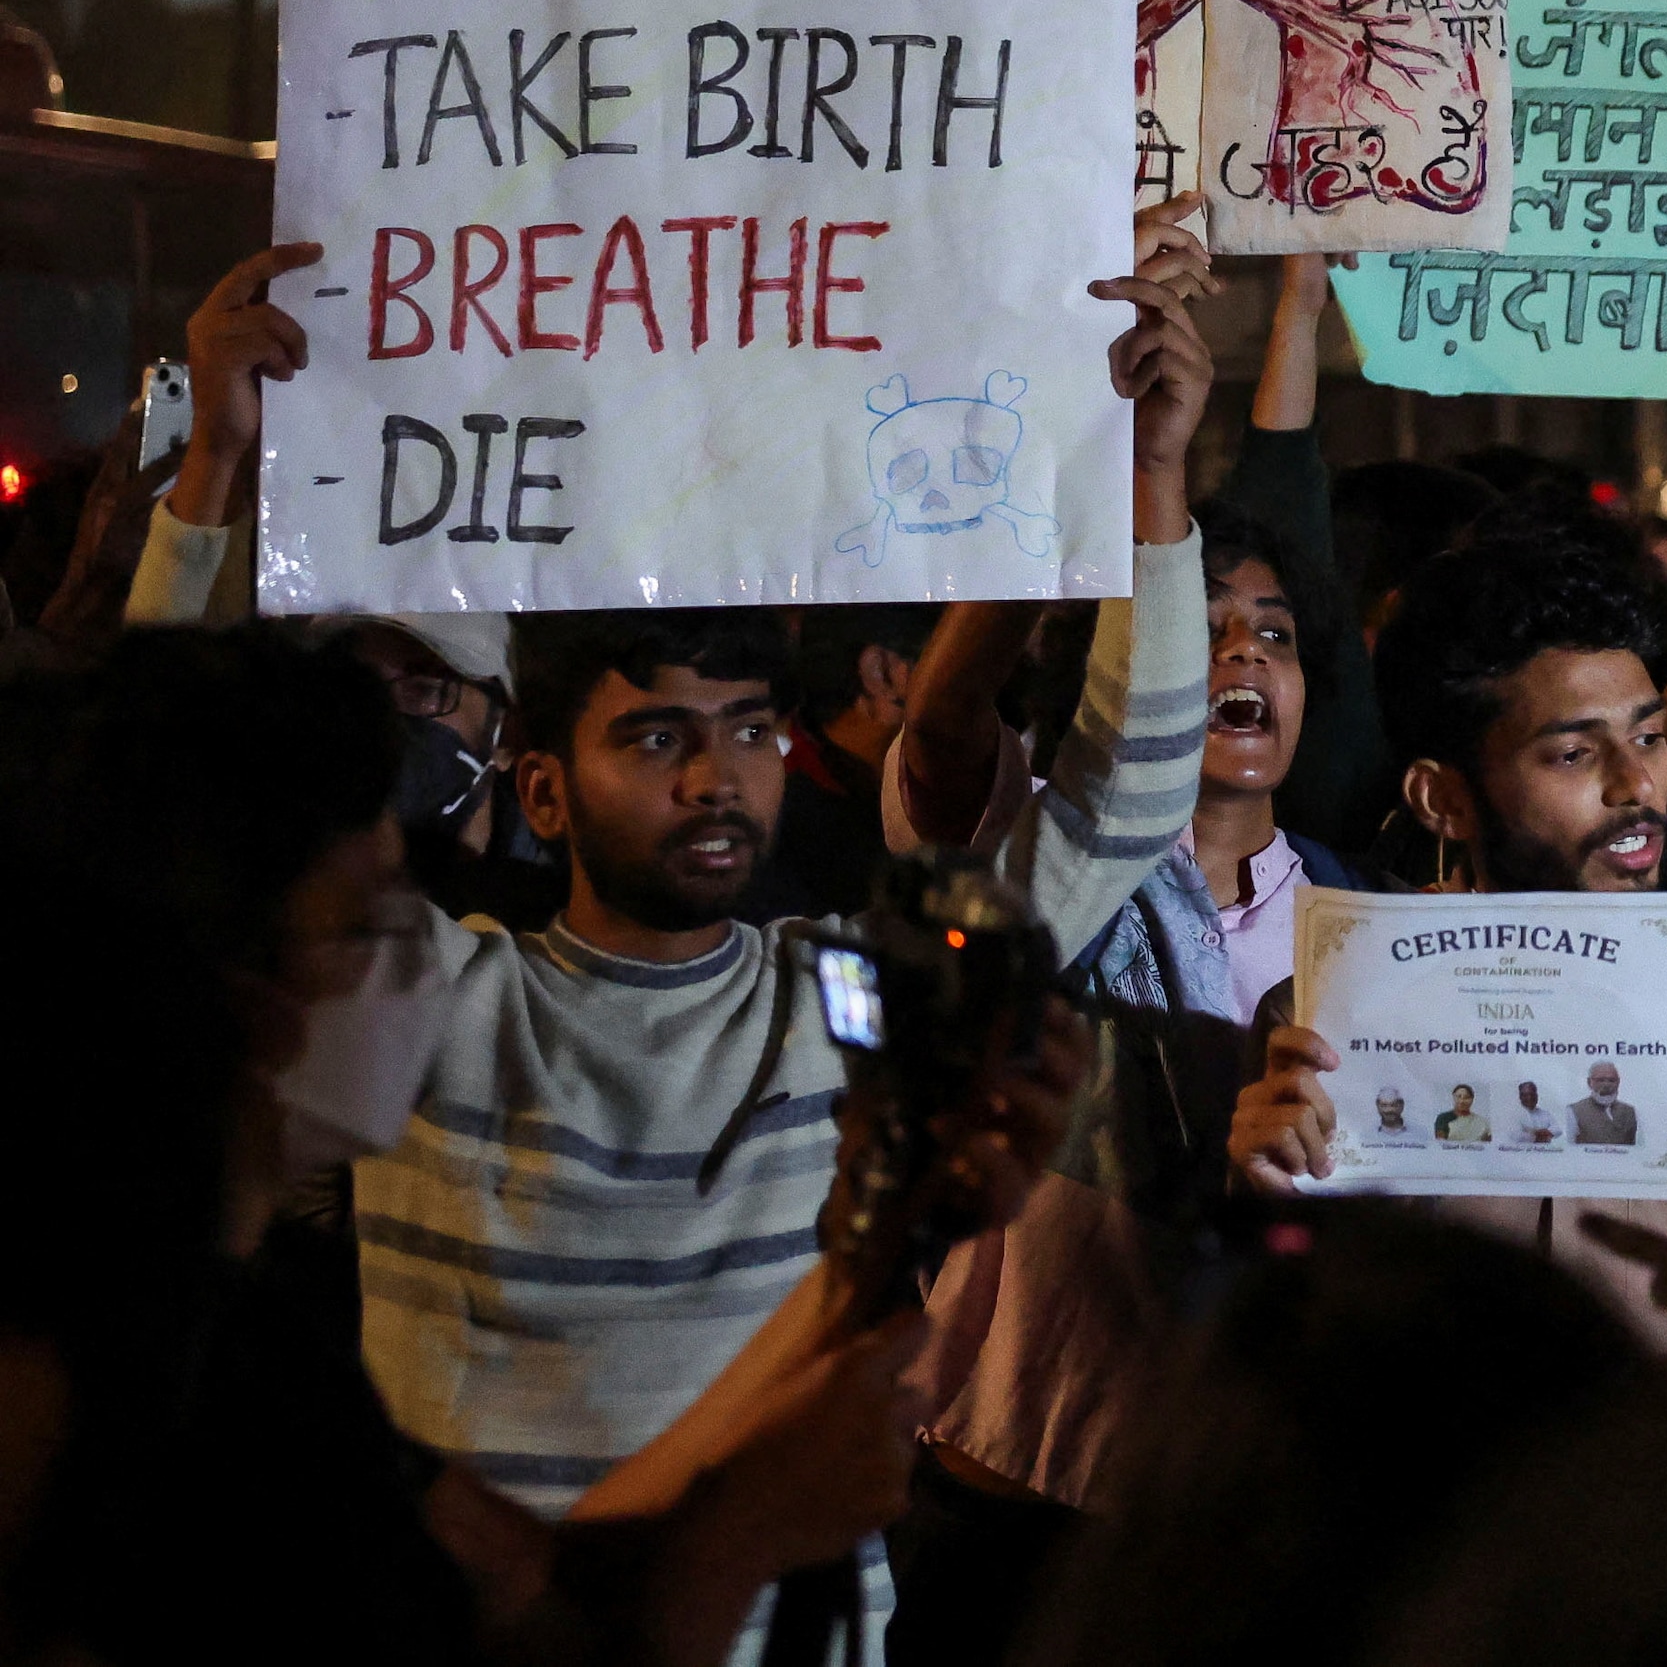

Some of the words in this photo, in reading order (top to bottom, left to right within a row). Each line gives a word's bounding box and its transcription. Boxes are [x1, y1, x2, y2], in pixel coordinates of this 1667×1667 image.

[684, 19, 1012, 173] BIRTH
[366, 214, 892, 361] BREATHE
[377, 412, 588, 547] DIE
[1390, 923, 1622, 964] CERTIFICATE
[1453, 966, 1563, 978] CONTAMINATION
[1476, 1002, 1536, 1021] INDIA
[1500, 1026, 1530, 1038] being
[1349, 1038, 1370, 1054] #1
[1375, 1038, 1422, 1054] Most
[1428, 1038, 1510, 1056] Polluted
[1515, 1039, 1580, 1056] Nation
[1585, 1043, 1610, 1057] on
[1615, 1040, 1667, 1057] Earth
